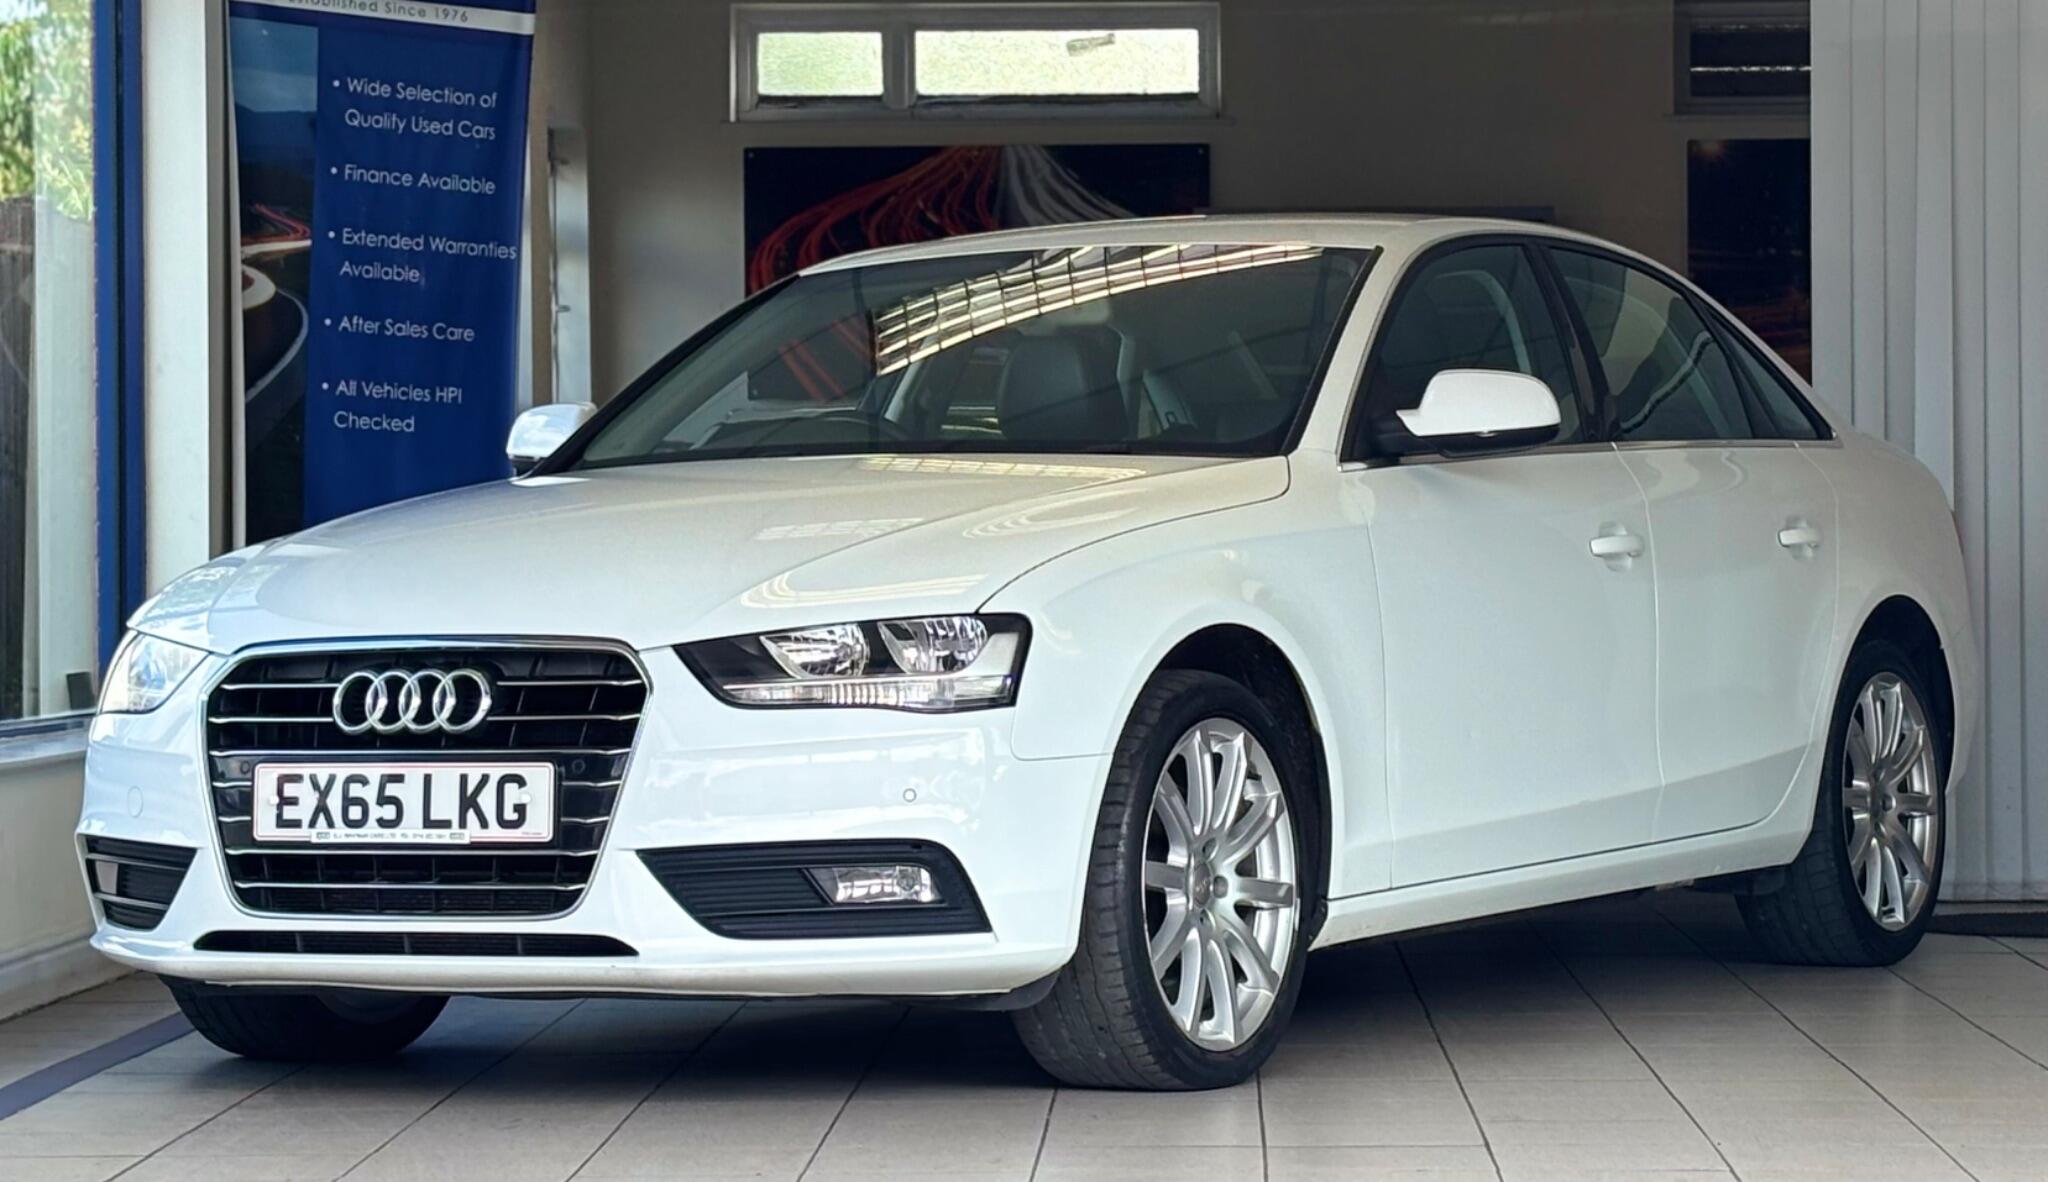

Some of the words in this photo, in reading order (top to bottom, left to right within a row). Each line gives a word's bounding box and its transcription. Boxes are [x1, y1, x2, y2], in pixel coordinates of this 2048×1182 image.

[289, 0, 378, 13] ablished
[384, 4, 427, 19] Since
[434, 9, 470, 24] 1976
[347, 77, 391, 98] Wide
[396, 82, 476, 107] Selection
[479, 92, 498, 109] of
[344, 109, 407, 135] Quality
[411, 117, 454, 136] Used
[457, 120, 496, 141] Cars
[344, 164, 413, 187] Finance
[417, 173, 496, 195] Available
[342, 228, 425, 251] Extended
[429, 236, 517, 260] Warranties
[339, 261, 420, 283] Available
[338, 315, 381, 335] After
[384, 318, 429, 338] Sales
[432, 323, 475, 342] Care
[335, 380, 358, 397] All
[361, 381, 431, 402] Vehicles
[435, 388, 462, 404] HPI
[333, 411, 416, 433] Checked
[275, 773, 405, 829] EX65
[422, 773, 528, 829] LKG
